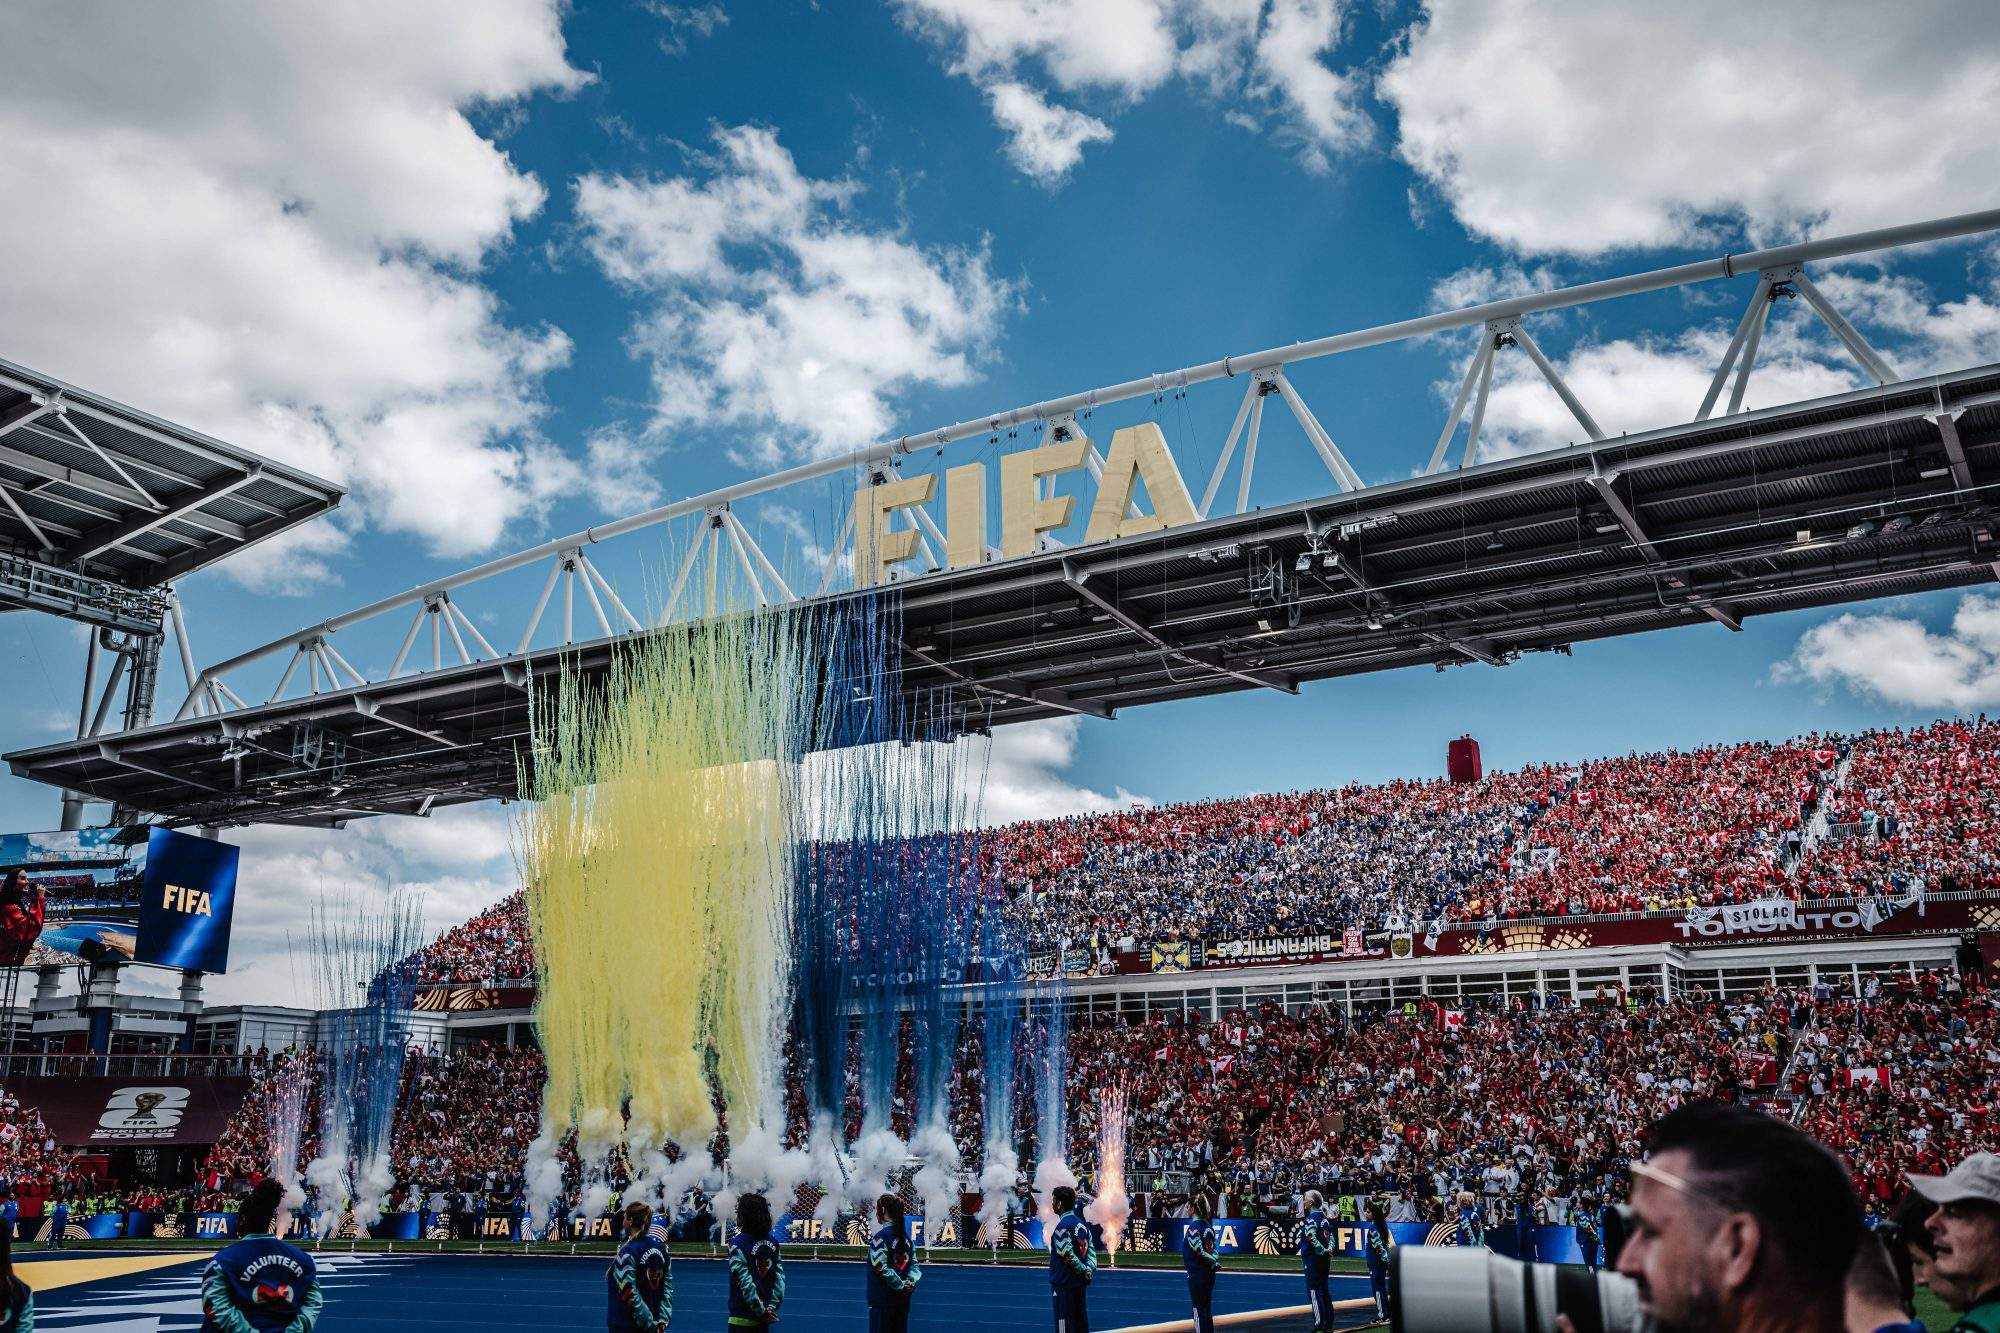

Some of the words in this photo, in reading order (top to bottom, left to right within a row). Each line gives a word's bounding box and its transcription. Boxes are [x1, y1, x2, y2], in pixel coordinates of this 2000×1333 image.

[855, 422, 1203, 588] FIFA
[163, 884, 212, 917] FIFA
[1733, 906, 1789, 923] STOLAC
[196, 1218, 228, 1234] FIFA
[475, 1217, 511, 1236] IFA
[240, 1255, 303, 1281] VOLUNTEER
